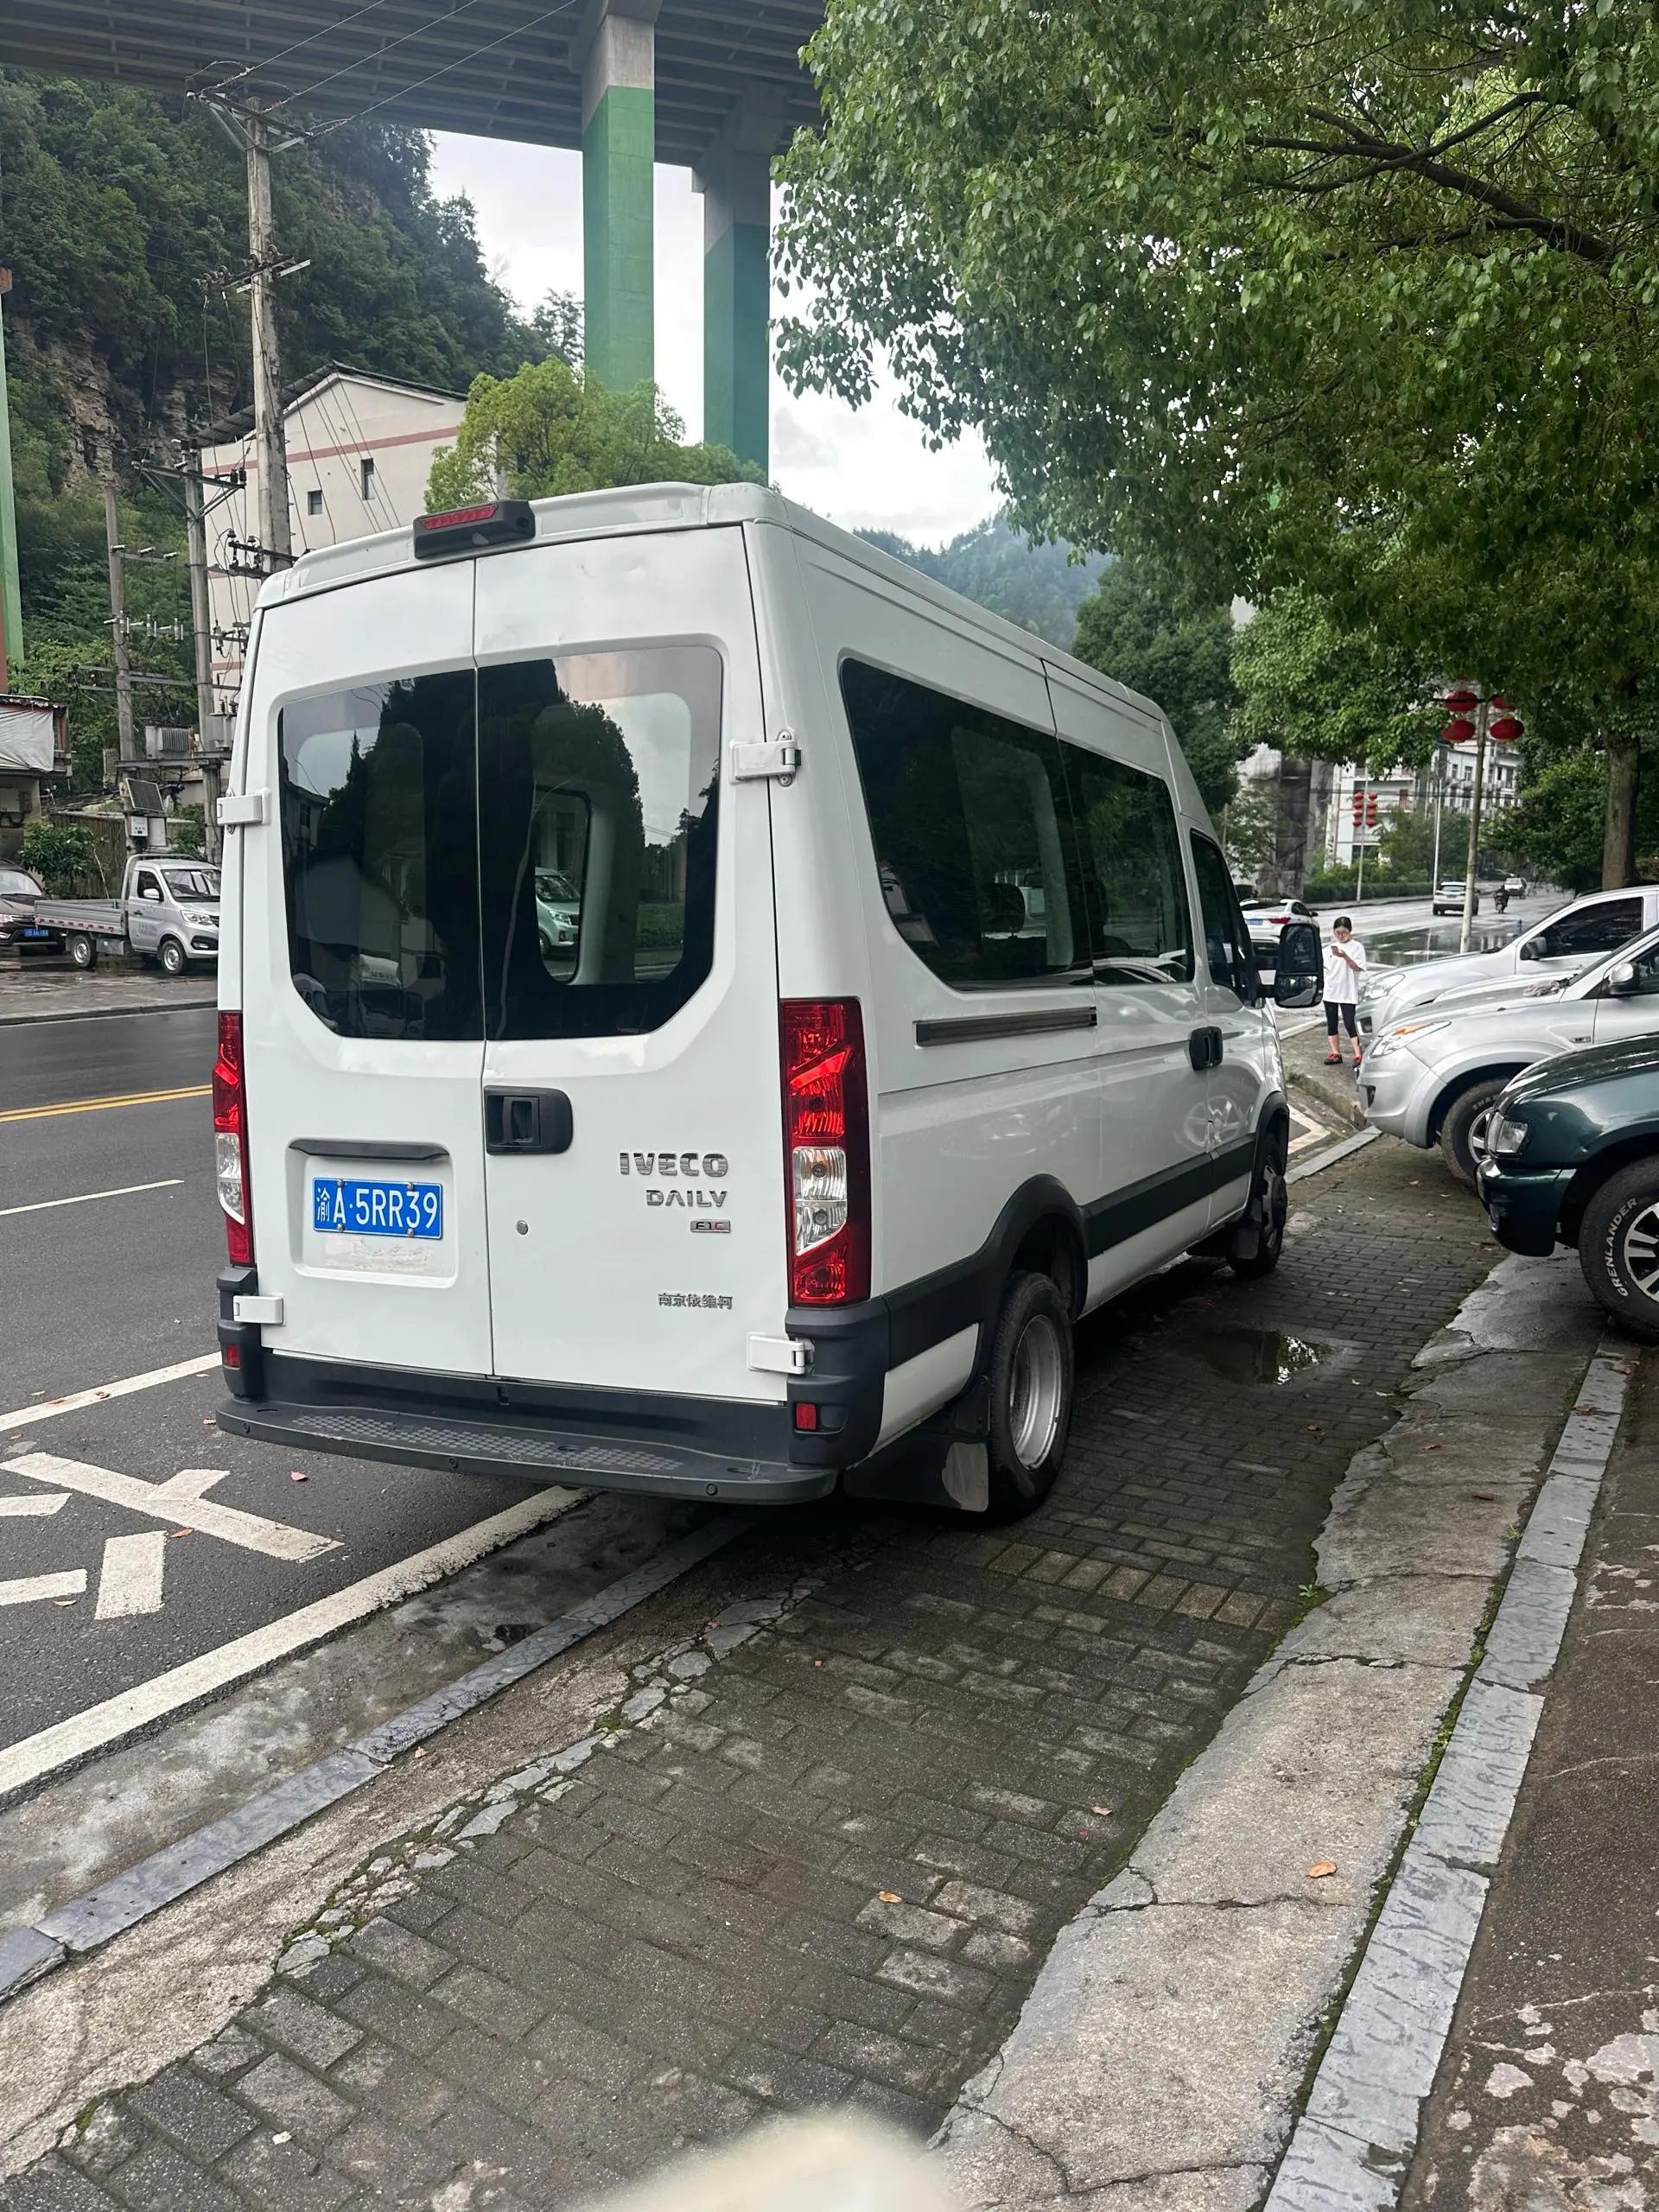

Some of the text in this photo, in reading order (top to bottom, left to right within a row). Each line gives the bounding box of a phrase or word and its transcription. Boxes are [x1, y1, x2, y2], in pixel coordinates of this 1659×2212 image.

[620, 1152, 728, 1178] IVECO
[645, 1189, 728, 1208] DAILY
[1605, 1197, 1638, 1297] GRENLANDER
[658, 1292, 734, 1310] 南京依维柯
